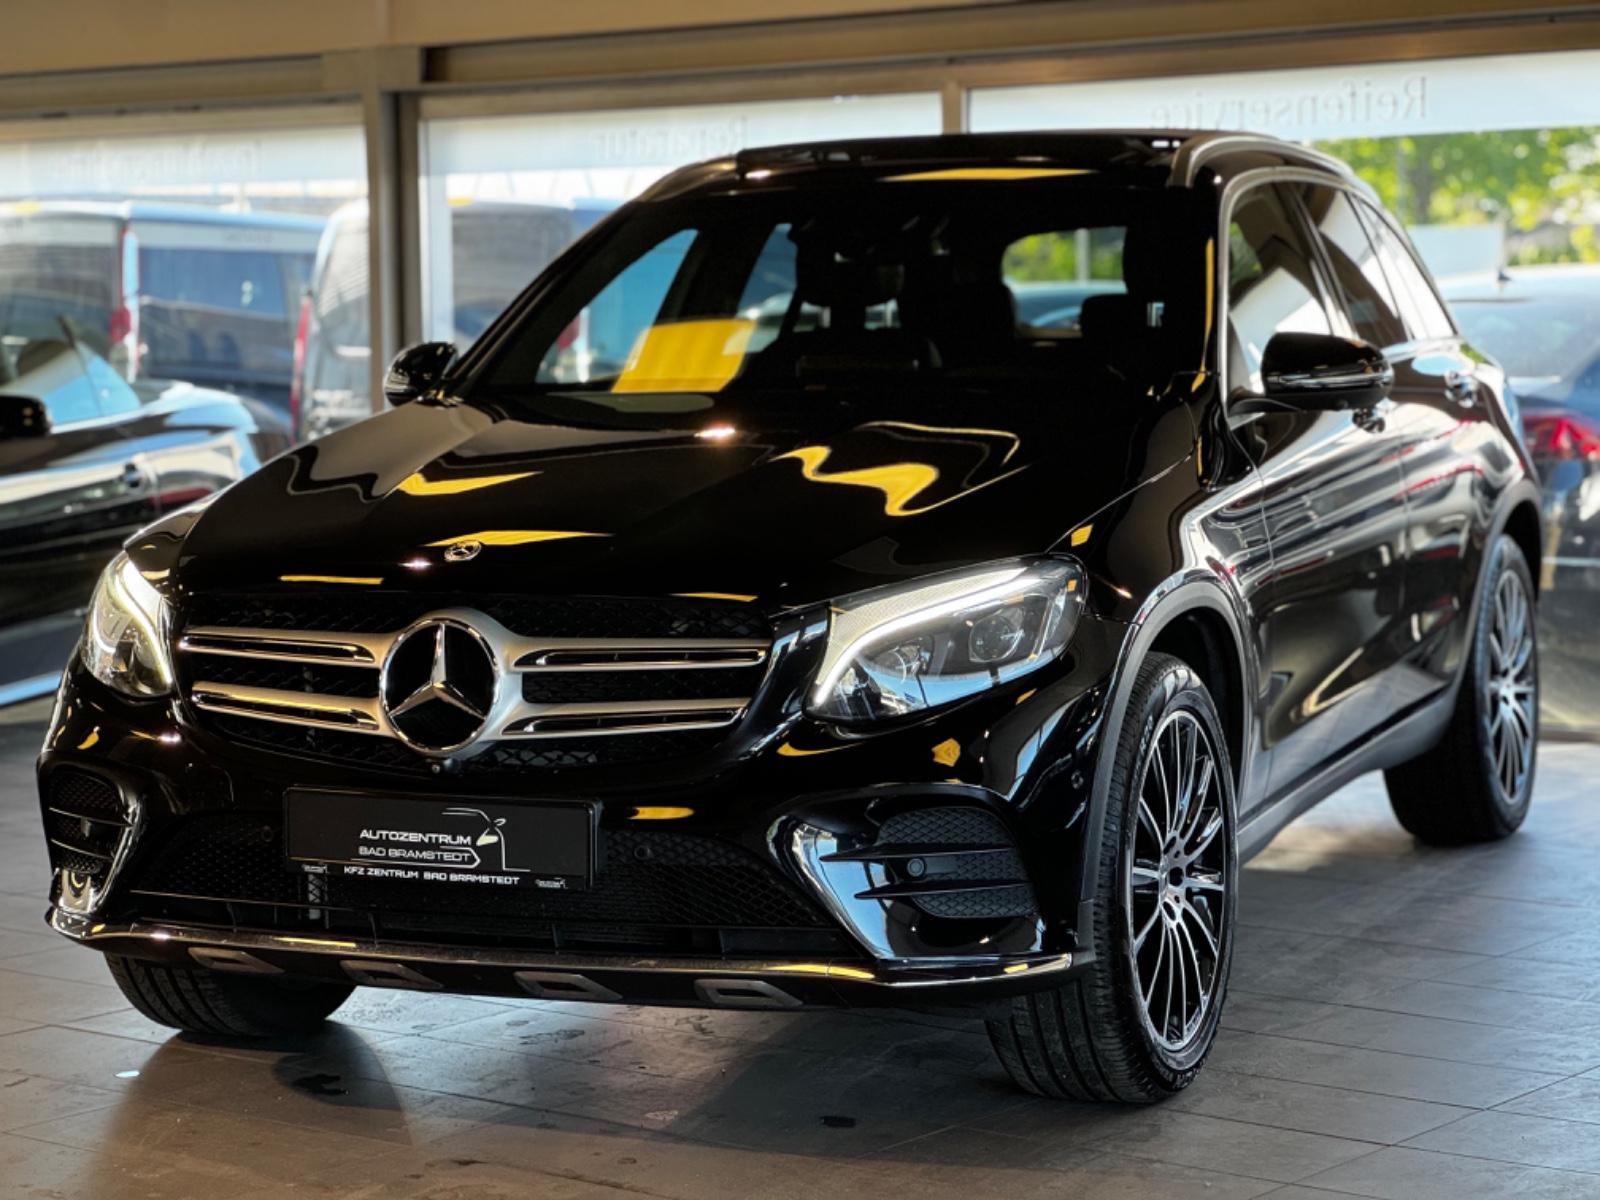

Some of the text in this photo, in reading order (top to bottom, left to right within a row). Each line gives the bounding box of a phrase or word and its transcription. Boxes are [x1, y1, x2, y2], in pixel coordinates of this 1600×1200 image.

[359, 829, 472, 845] AUTOZENTRUM
[358, 846, 471, 862] BAD BRAMSTEDT
[344, 866, 520, 885] KFZ ZENTRUM BAD BRAMSTEDT
